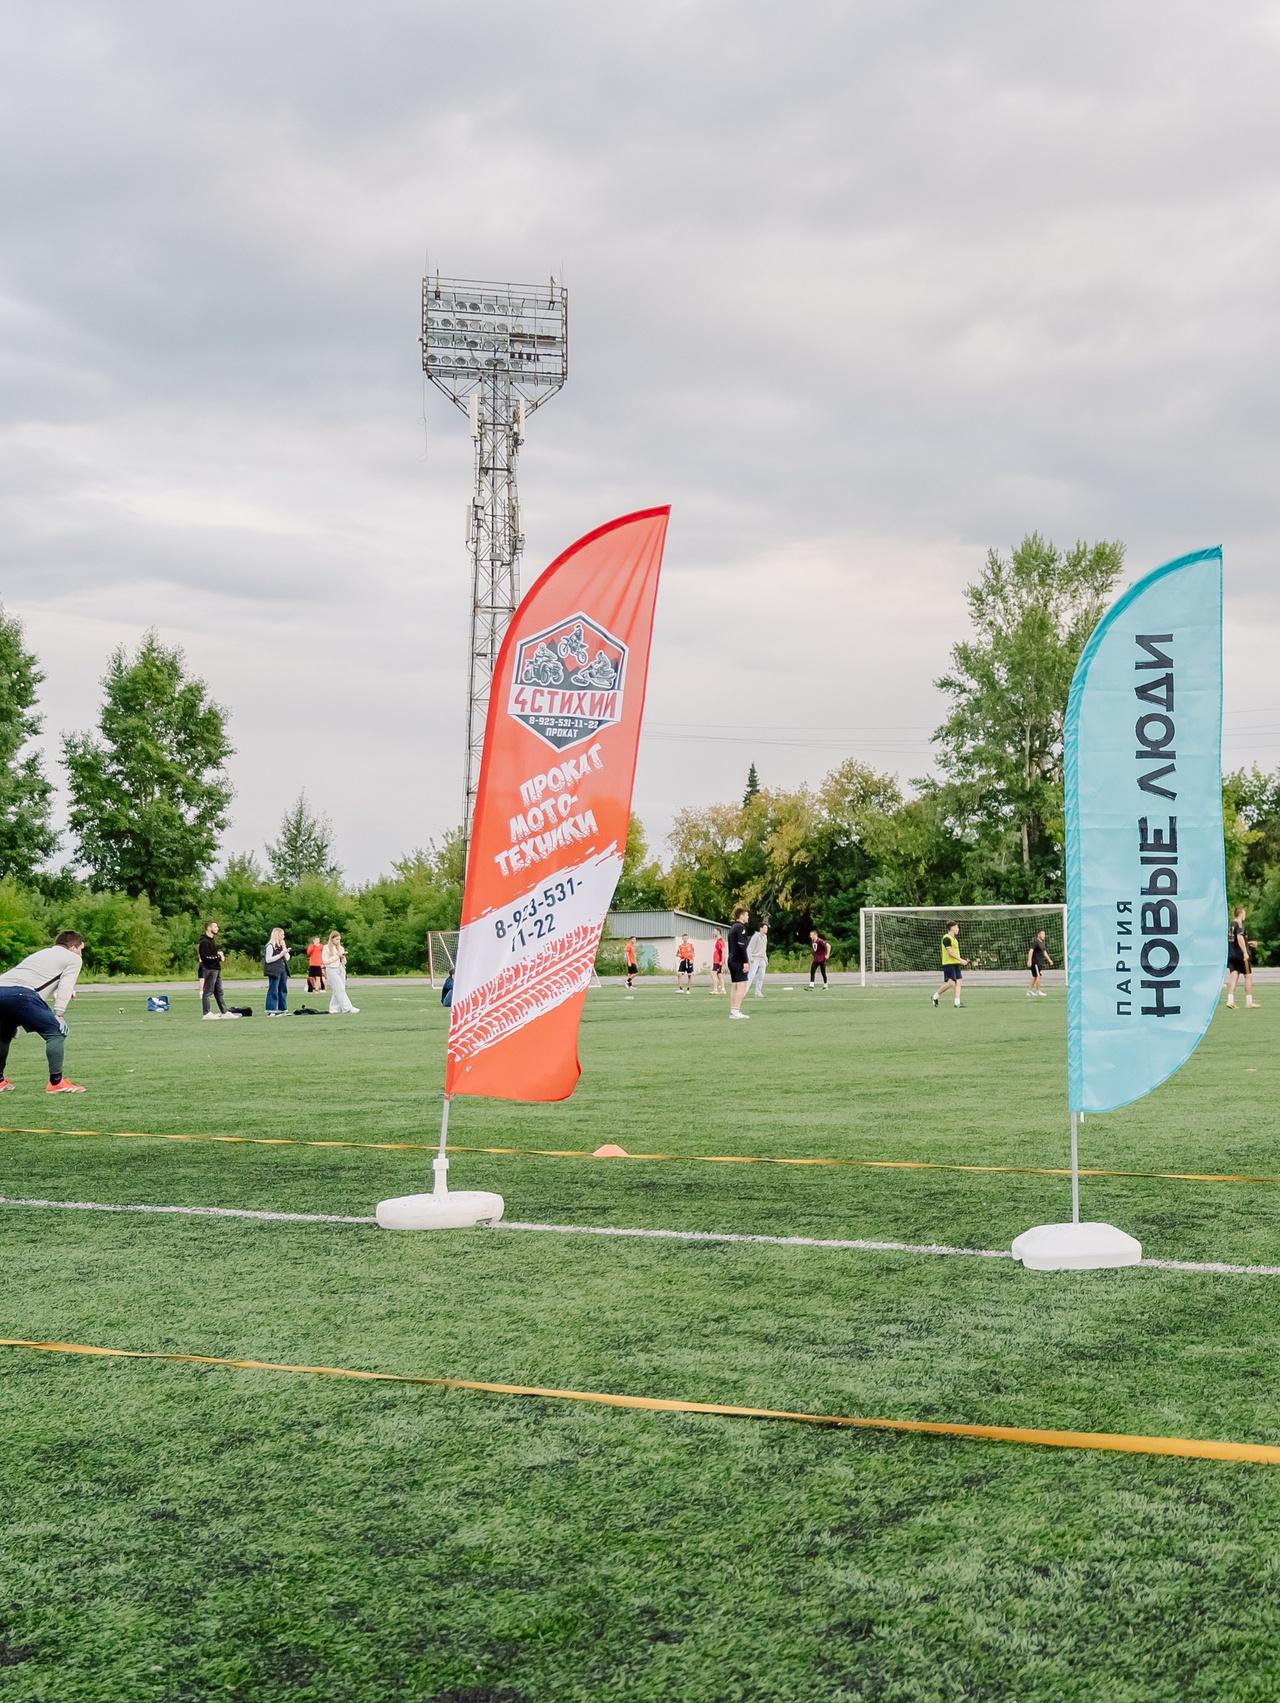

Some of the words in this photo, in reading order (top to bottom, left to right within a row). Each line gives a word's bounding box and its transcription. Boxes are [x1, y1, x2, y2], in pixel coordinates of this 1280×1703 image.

[529, 716, 599, 729] 8-923-531-11-22
[545, 728, 579, 738] ПРОКАТ
[1134, 633, 1178, 802] ЛЮДИ
[519, 743, 604, 807] ПРОКАТ
[494, 809, 600, 877] ТЕХНИКИ
[509, 793, 579, 843] МОТО-
[1138, 815, 1181, 1018] НОВЫЕ
[1116, 901, 1133, 1016] ПАРТИЯ
